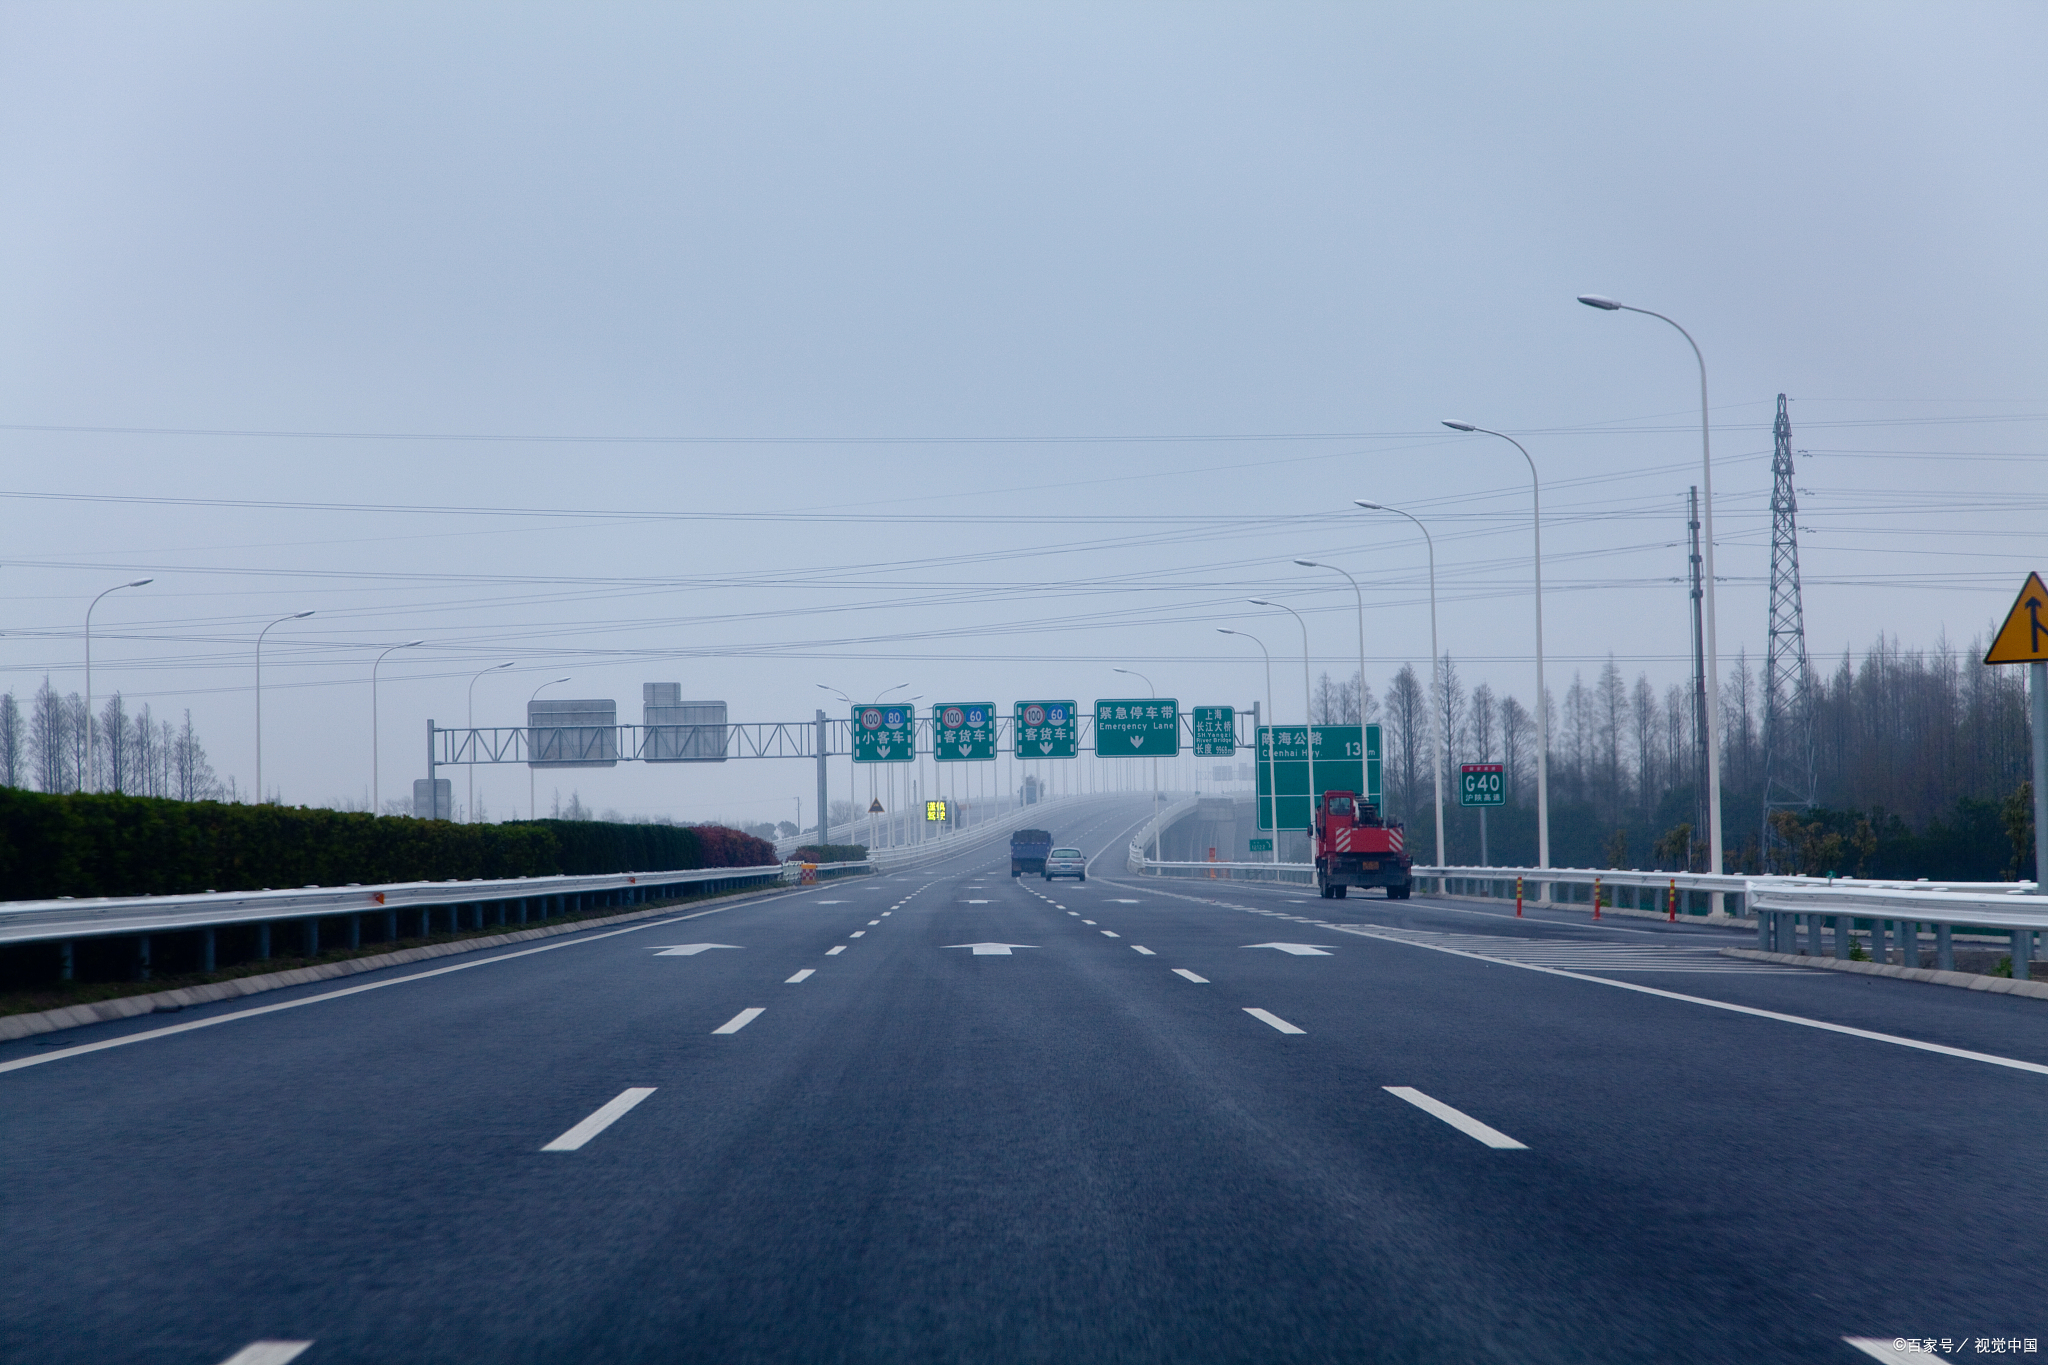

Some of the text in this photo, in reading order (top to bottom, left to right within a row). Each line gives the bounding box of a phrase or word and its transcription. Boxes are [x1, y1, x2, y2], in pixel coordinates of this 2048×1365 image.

[888, 712, 900, 723] 80
[946, 712, 960, 724] 100
[969, 711, 982, 722] 60
[1028, 710, 1041, 721] 100
[1051, 709, 1063, 720] 60
[1099, 705, 1174, 720] 紧急停车带
[1205, 709, 1222, 720] 上海
[865, 713, 879, 725] 100
[1099, 721, 1174, 732] Emergency Lane
[1196, 720, 1231, 732] 长江大桥
[862, 731, 905, 745] 小客车
[944, 729, 986, 743] 客货车
[1025, 727, 1067, 741] 客货车
[1196, 743, 1212, 754] 长度
[1262, 749, 1323, 758] Cenhai Hy.
[1465, 774, 1500, 792] G40
